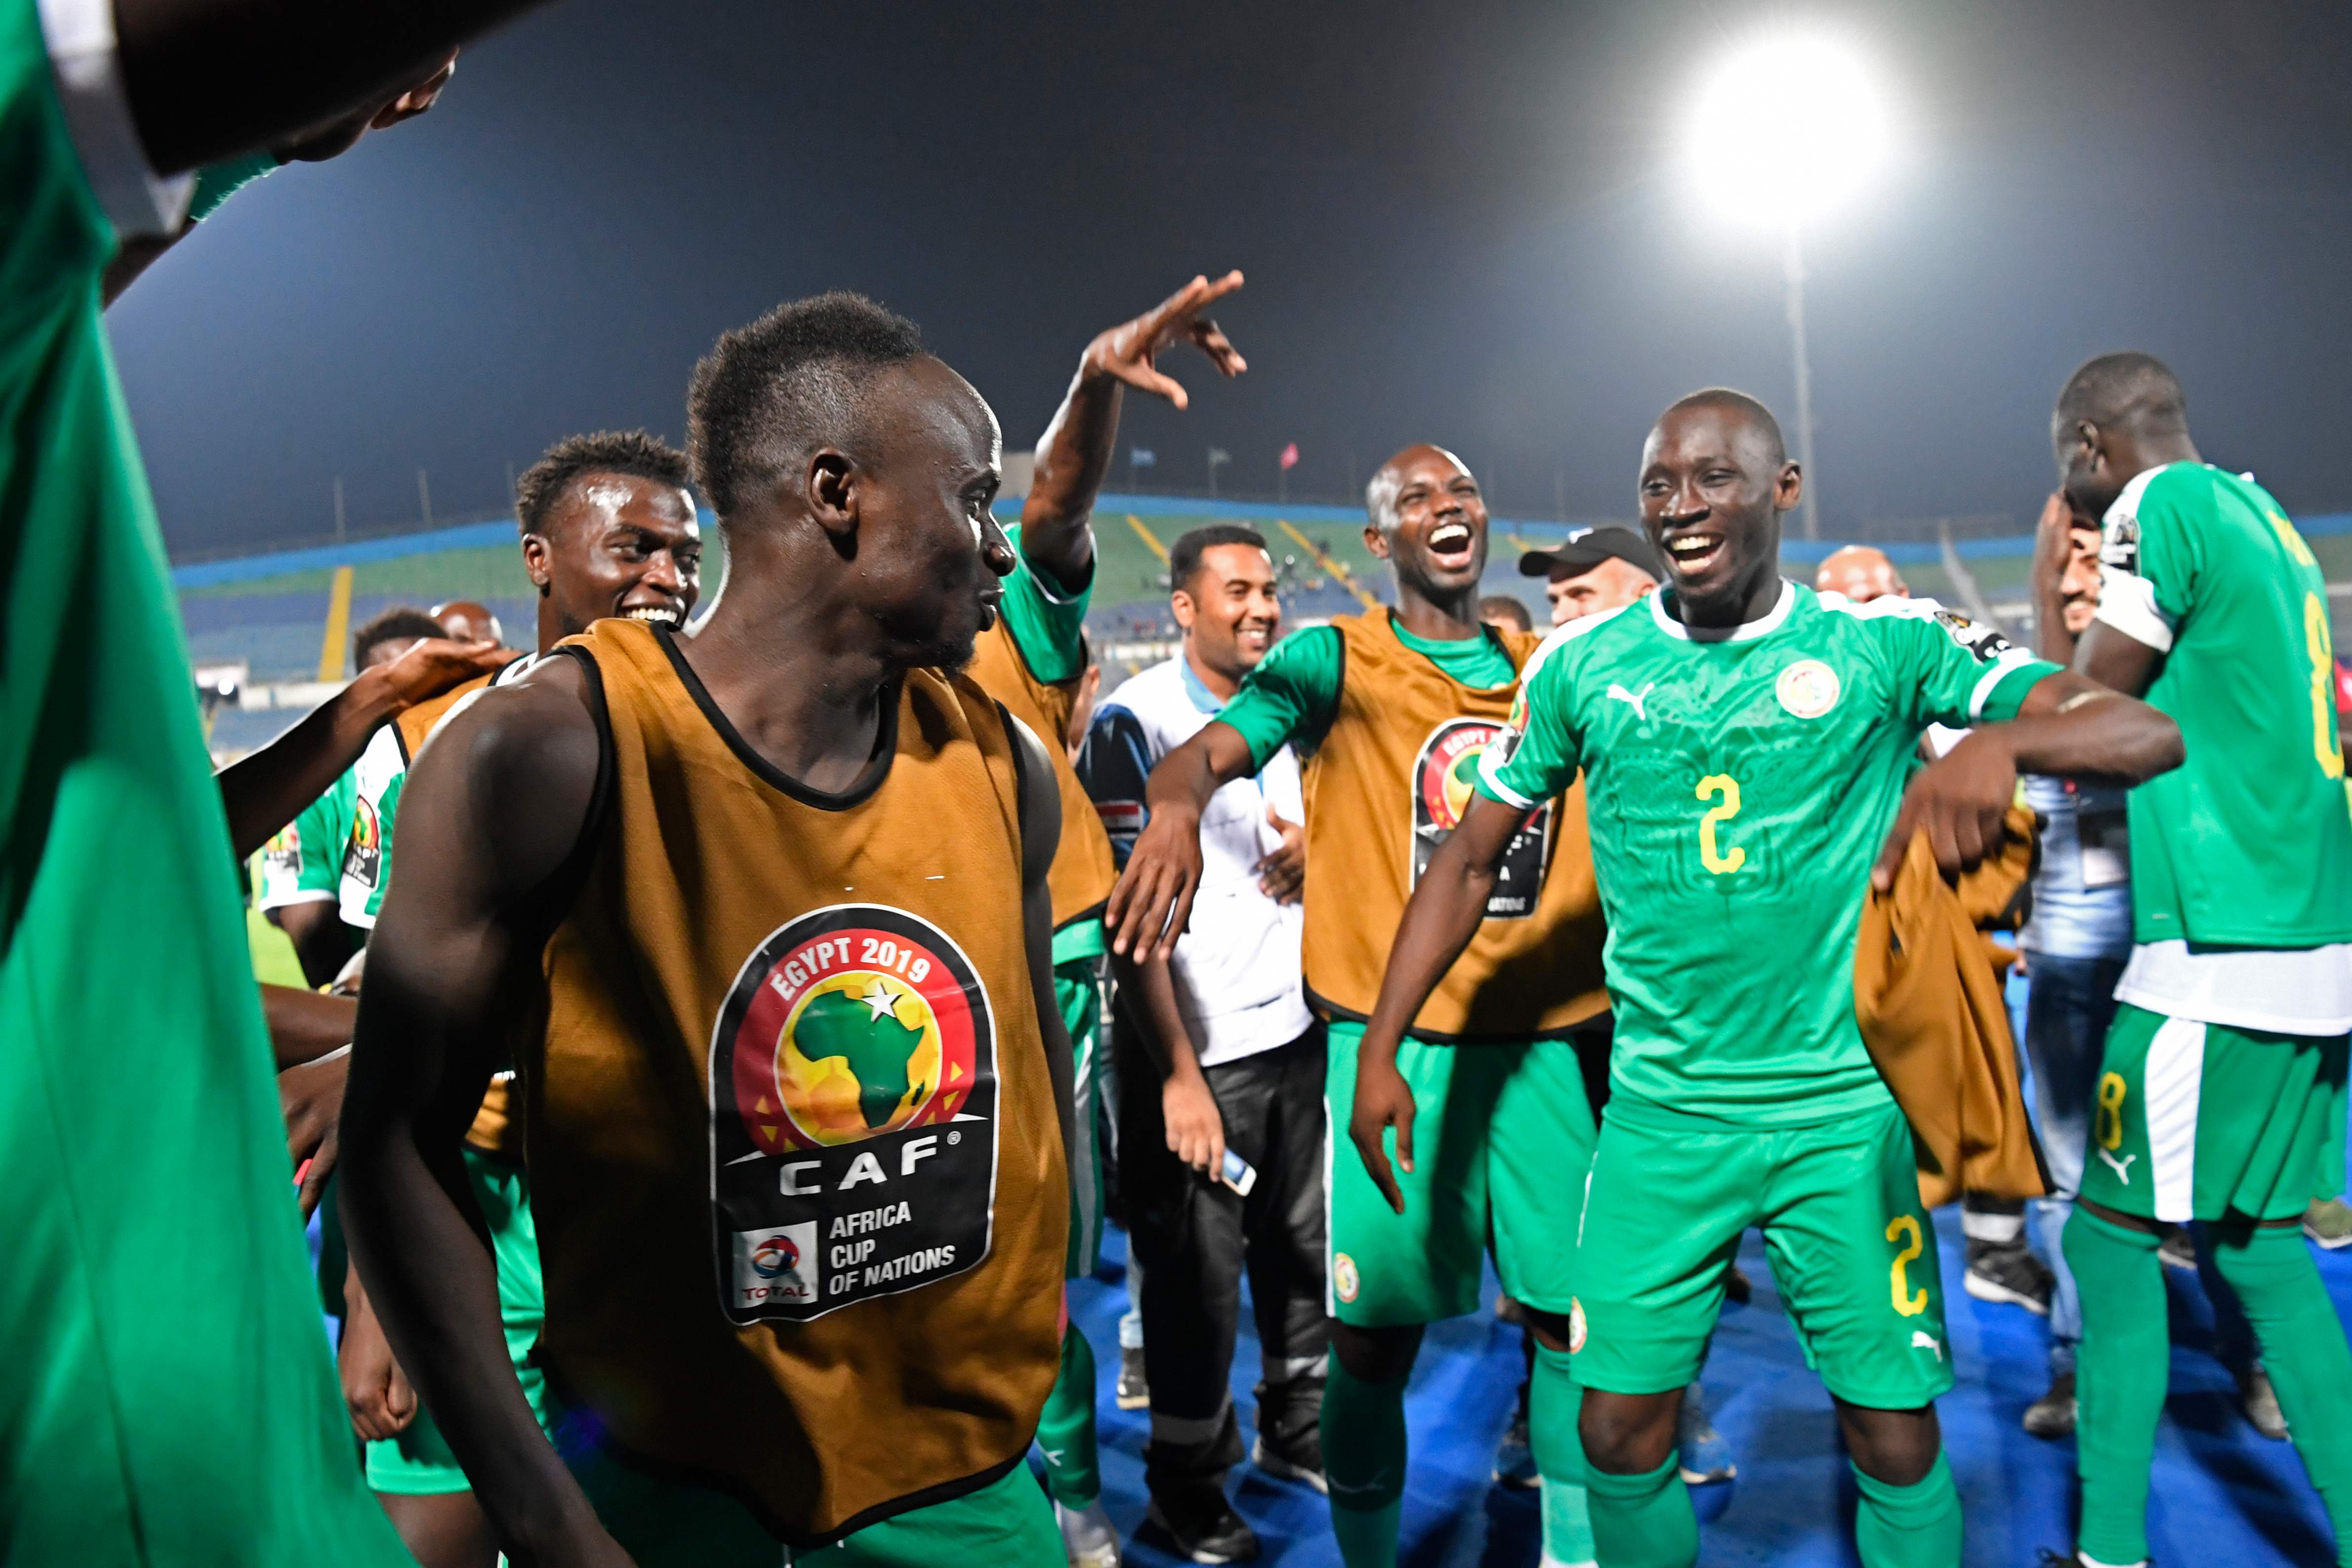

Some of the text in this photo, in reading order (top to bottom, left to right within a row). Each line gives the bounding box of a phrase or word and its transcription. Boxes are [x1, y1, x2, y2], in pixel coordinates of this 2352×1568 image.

[1695, 773, 1745, 874] 2
[771, 937, 931, 1001] EGYPT 2019
[2096, 1071, 2126, 1150] 8
[779, 1135, 938, 1196] CAF
[829, 1201, 912, 1239] AFRICA
[829, 1245, 956, 1295] OF NATIONS
[830, 1239, 875, 1269] CUP
[1885, 1215, 1928, 1317] 2
[744, 1286, 811, 1300] TOTAL
